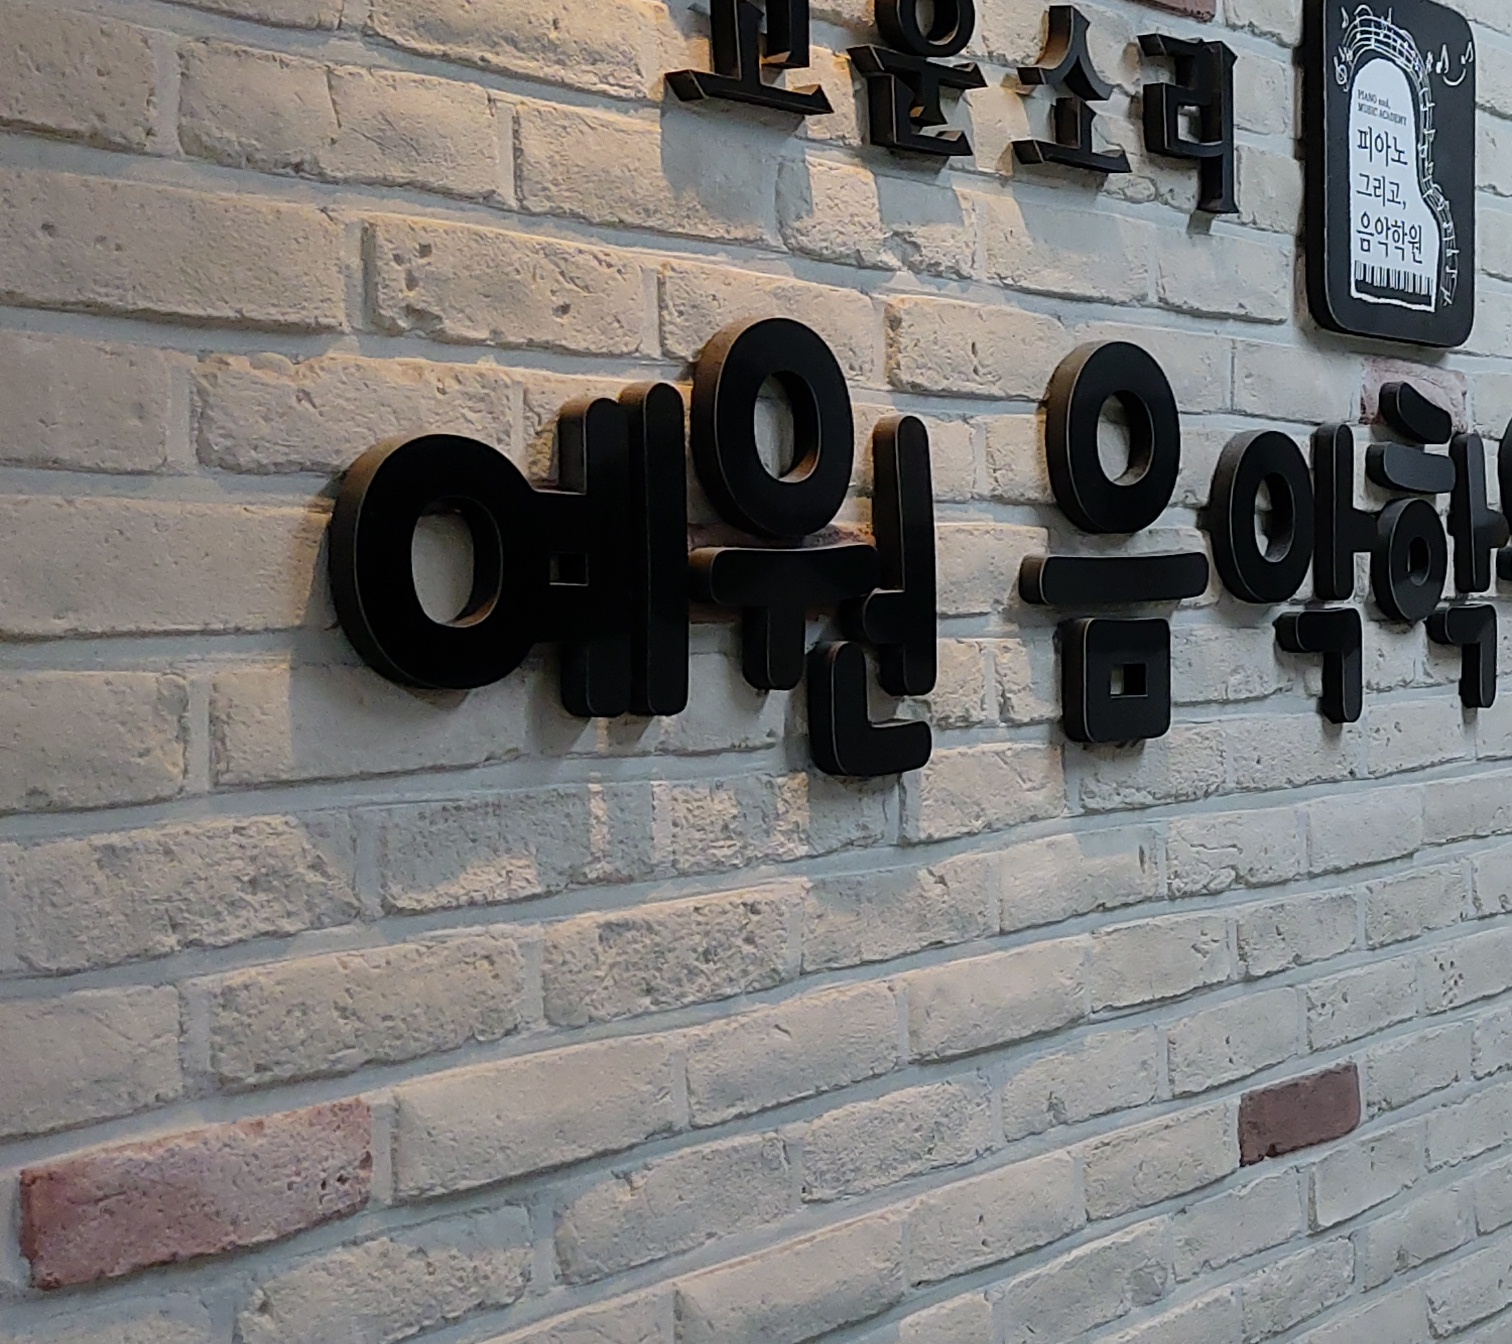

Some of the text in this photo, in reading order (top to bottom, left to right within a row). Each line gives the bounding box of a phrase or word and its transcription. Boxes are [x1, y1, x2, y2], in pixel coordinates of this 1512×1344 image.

[1357, 88, 1378, 105] PIANO
[1357, 102, 1378, 117] MUSIC
[1356, 125, 1408, 167] 피아노
[1355, 172, 1407, 210] 그리고,
[1355, 211, 1423, 264] 음악학원
[330, 316, 937, 778] 예원
